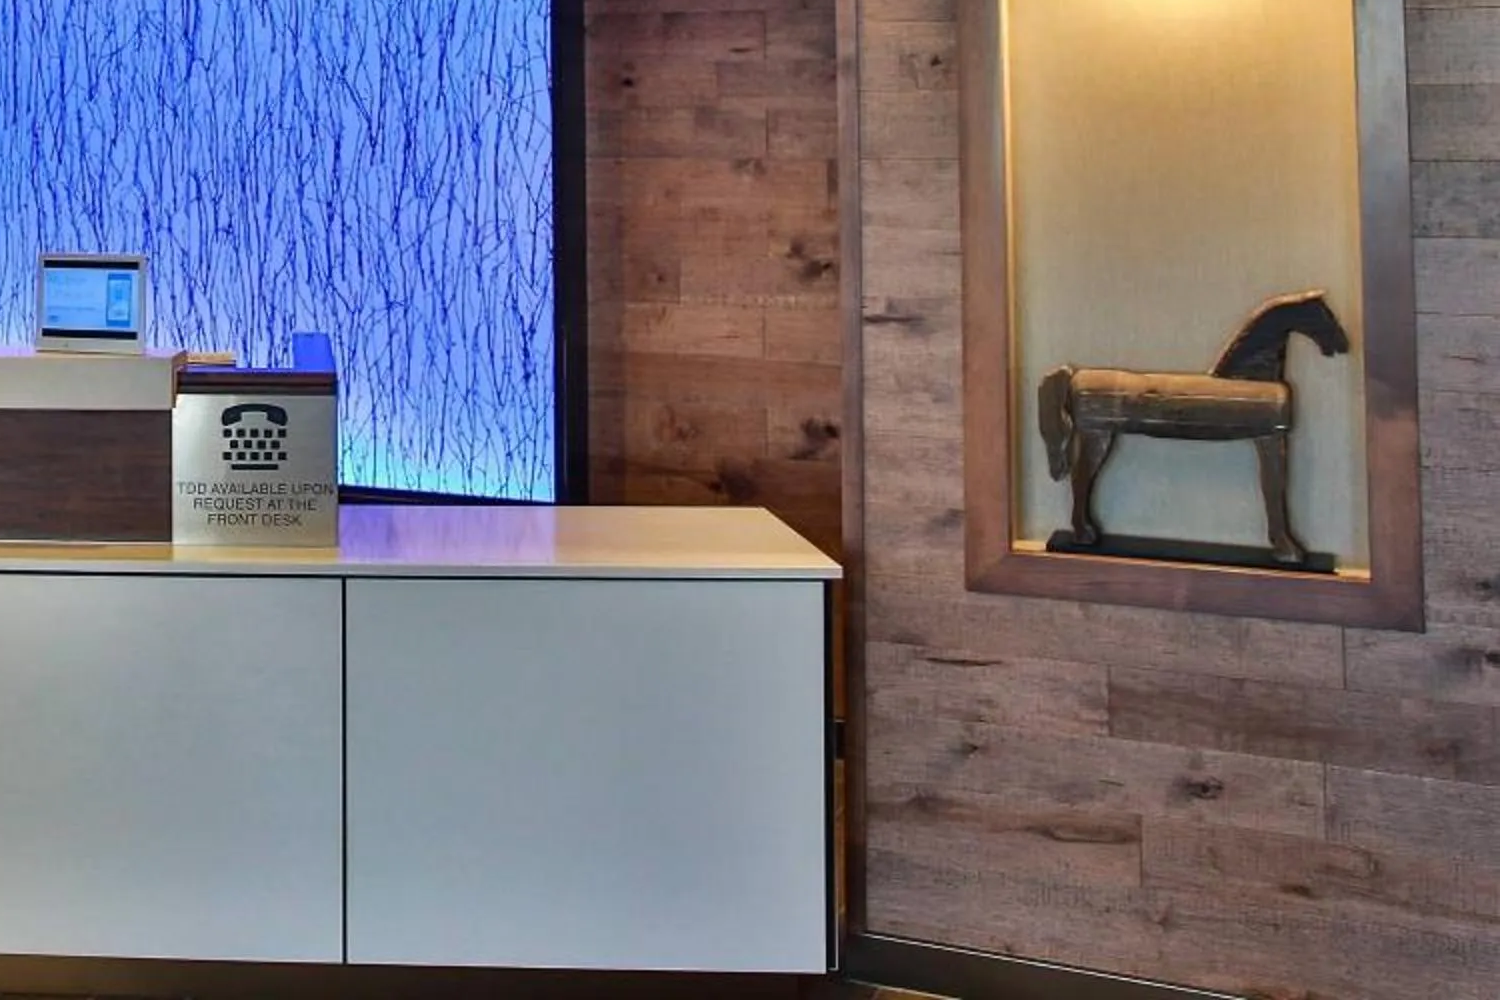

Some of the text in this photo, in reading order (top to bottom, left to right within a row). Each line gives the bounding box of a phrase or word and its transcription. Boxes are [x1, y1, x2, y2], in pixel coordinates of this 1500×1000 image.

[178, 482, 334, 495] TDD AVAILABLE UPON
[193, 498, 317, 511] REQUEST AT THE
[207, 513, 303, 526] FRONT DESK
